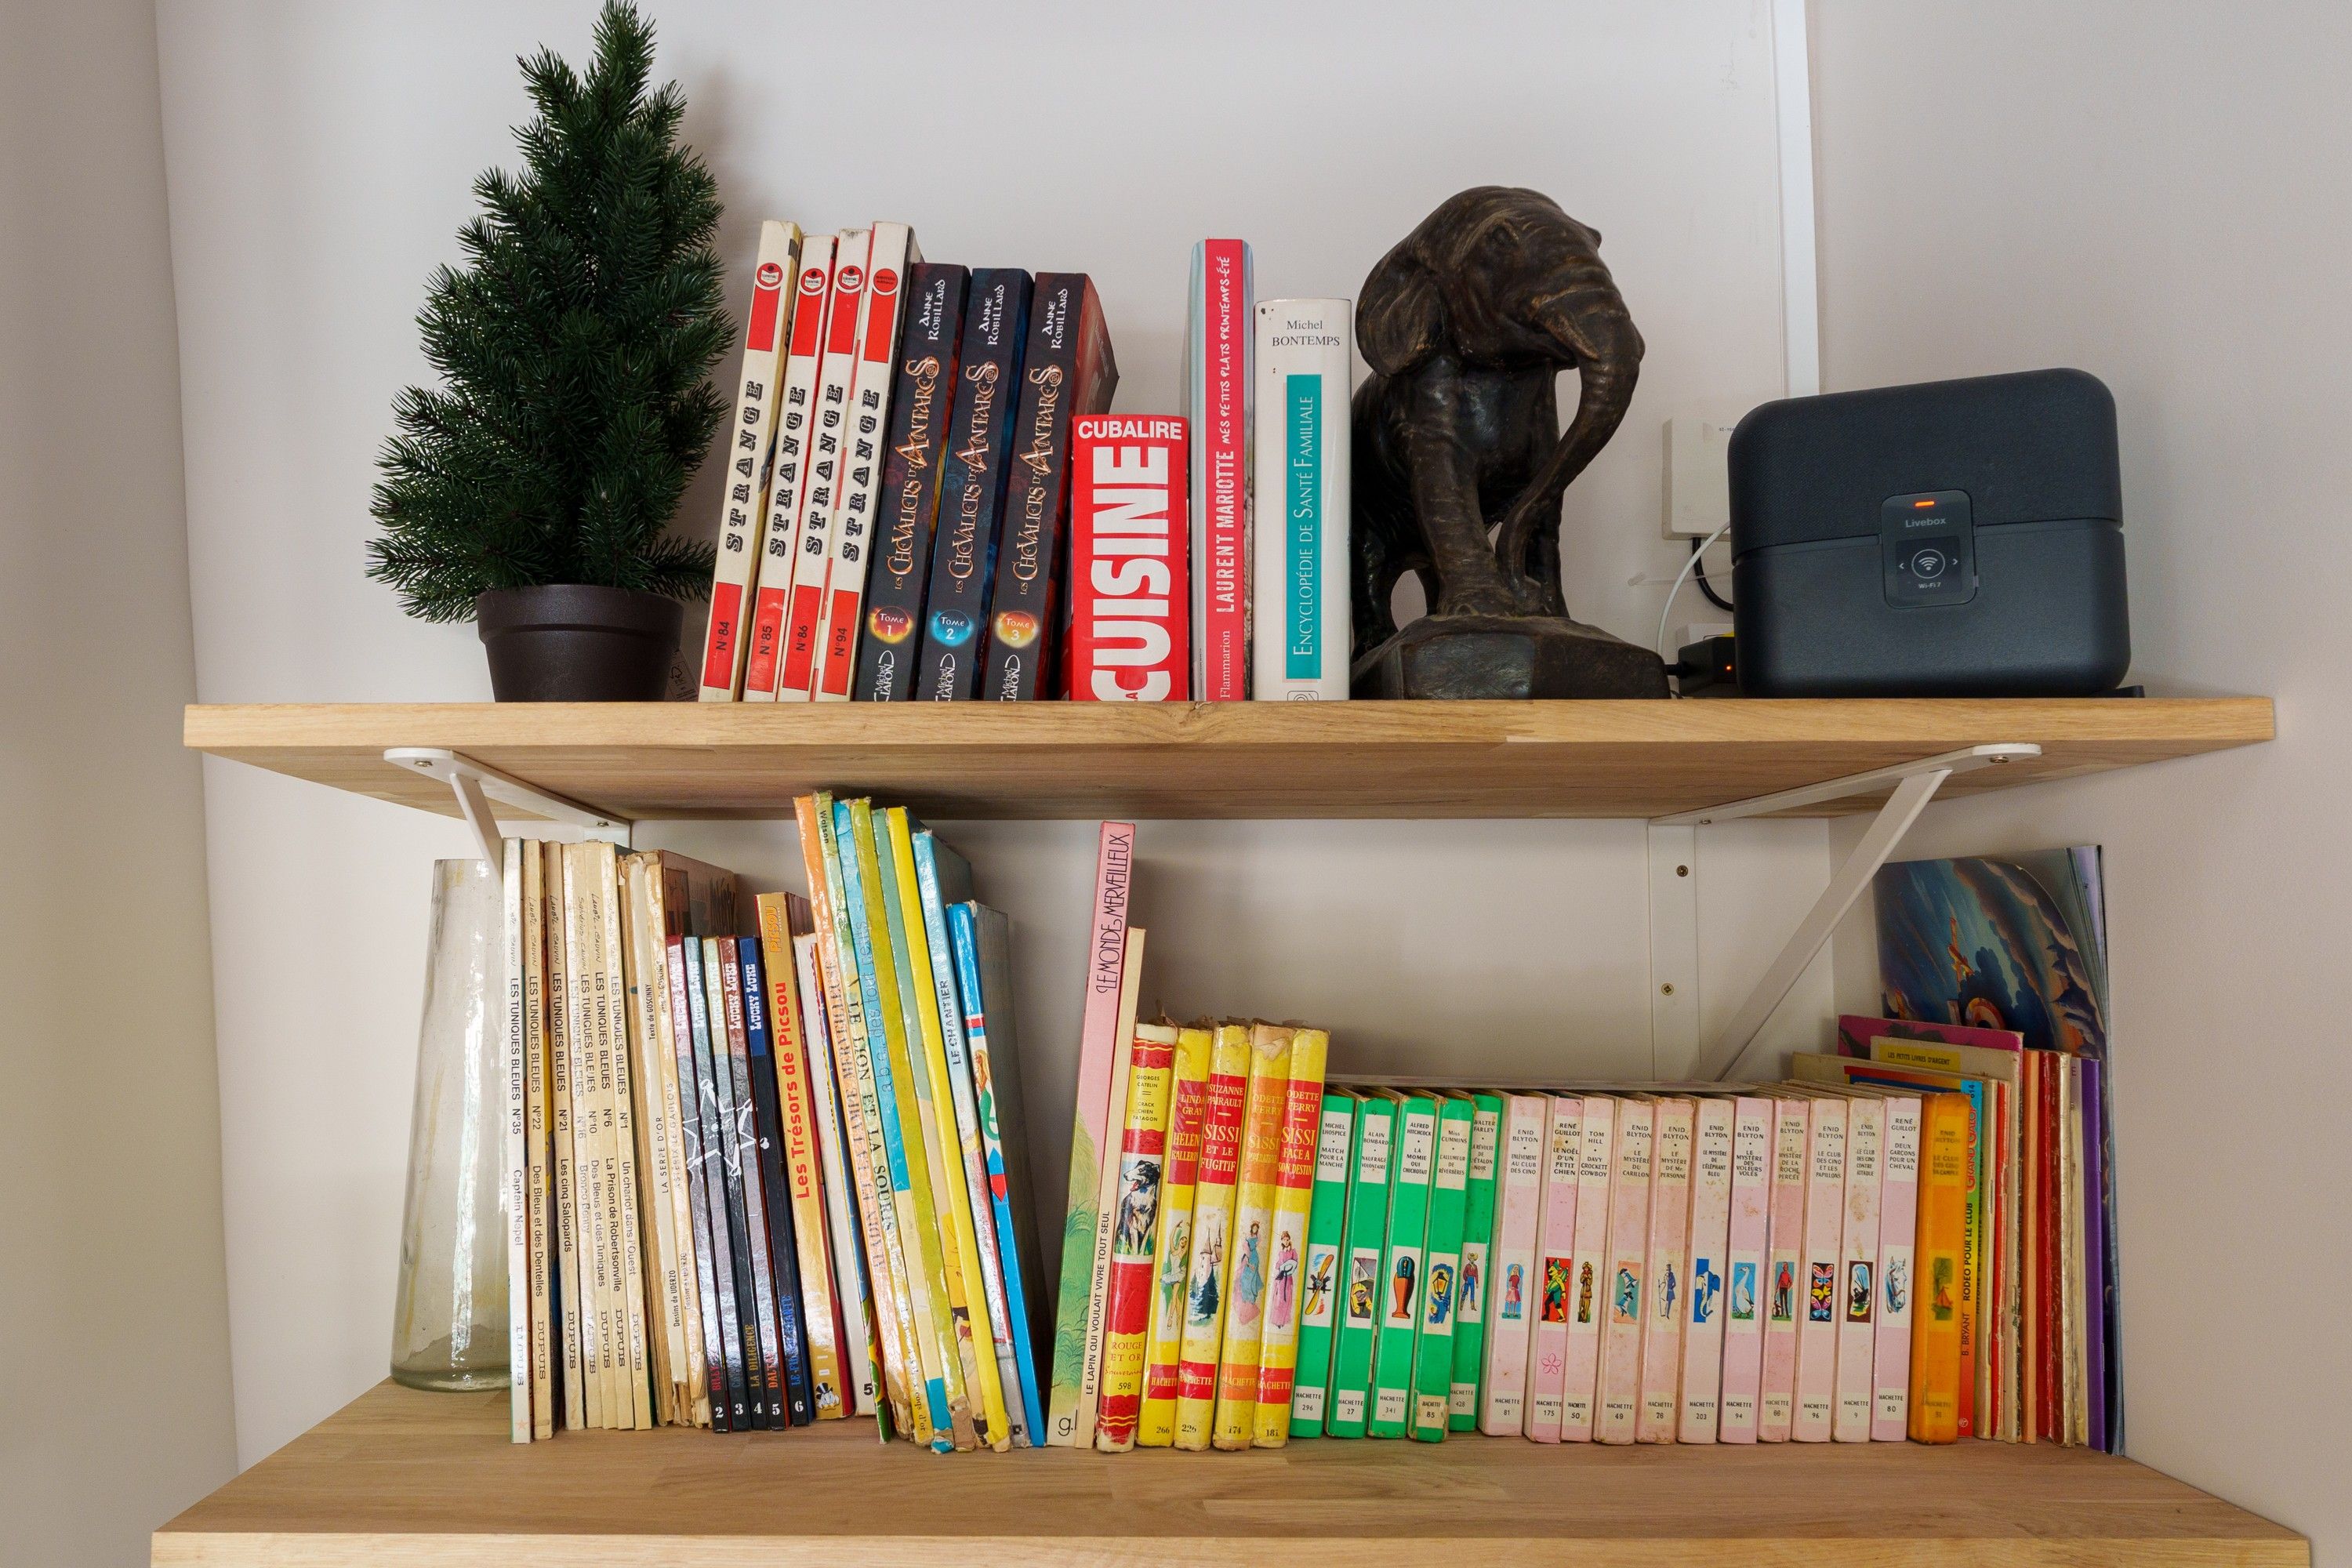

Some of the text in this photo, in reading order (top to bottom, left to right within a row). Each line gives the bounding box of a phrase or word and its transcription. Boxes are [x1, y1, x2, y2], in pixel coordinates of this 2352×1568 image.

[1287, 320, 1323, 330] Michel
[1272, 336, 1341, 347] BONTEMPS
[1219, 343, 1231, 377] PLATS
[1078, 420, 1182, 441] CUBALIRE
[1220, 420, 1231, 444] MES
[726, 381, 763, 553] STRANGE
[769, 386, 806, 557] STRANGE
[806, 384, 844, 556] STRANGE
[843, 389, 880, 562] STRANGE
[1216, 451, 1234, 528] MARIOTTE
[1293, 395, 1313, 657] ENCYCLOPÉDIE DE SANTÉ FAMILIALE
[1905, 518, 1947, 528] Livebox
[1216, 535, 1234, 613] LAURENT
[887, 625, 892, 637] 1
[946, 628, 954, 640] 2
[1011, 629, 1019, 641] 3
[1220, 630, 1231, 699] Flammarion
[553, 973, 562, 993] LES
[596, 972, 604, 992] LES
[553, 995, 564, 1048] TUNIQUES
[597, 994, 608, 1047] TUNIQUES
[556, 1051, 567, 1092] BLEUES
[601, 1051, 612, 1090] BLEUES
[775, 982, 810, 1198] Les Trésors de Picsou
[1209, 1083, 1244, 1096] SUZANNE
[1287, 1089, 1319, 1102] ODETTE
[1207, 1096, 1242, 1108] PAIRAULT
[1204, 1123, 1240, 1143] SISSI
[1281, 1127, 1316, 1146] SISSI
[1205, 1145, 1233, 1156] ET LE
[1283, 1148, 1304, 1160] FACE
[560, 1158, 569, 1176] Les
[606, 1157, 615, 1170] La
[1200, 1158, 1236, 1172] FUGITIF
[1278, 1162, 1313, 1175] SON DESTIN
[560, 1178, 572, 1200] cinq
[607, 1173, 616, 1202] Prison
[609, 1205, 617, 1220] de
[562, 1203, 573, 1253] Salopards
[1965, 1227, 1973, 1237] LE
[610, 1221, 622, 1292] Robertsonville
[669, 1269, 679, 1294] UDERZO
[1086, 1210, 1110, 1395] LE LAPIN QUI VOULAIT VIVRE TOUT SEUL
[615, 1308, 626, 1367] DUPUIS
[1962, 1312, 1970, 1346] BRYANT
[568, 1310, 577, 1369] DUPUIS
[1111, 1341, 1143, 1351] ROUGE
[1111, 1353, 1142, 1363] ET OR
[1117, 1382, 1132, 1391] 598
[715, 1406, 724, 1418] 2
[735, 1403, 743, 1415] 3
[753, 1402, 762, 1414] 4
[772, 1403, 780, 1415] 5
[794, 1400, 803, 1412] 6
